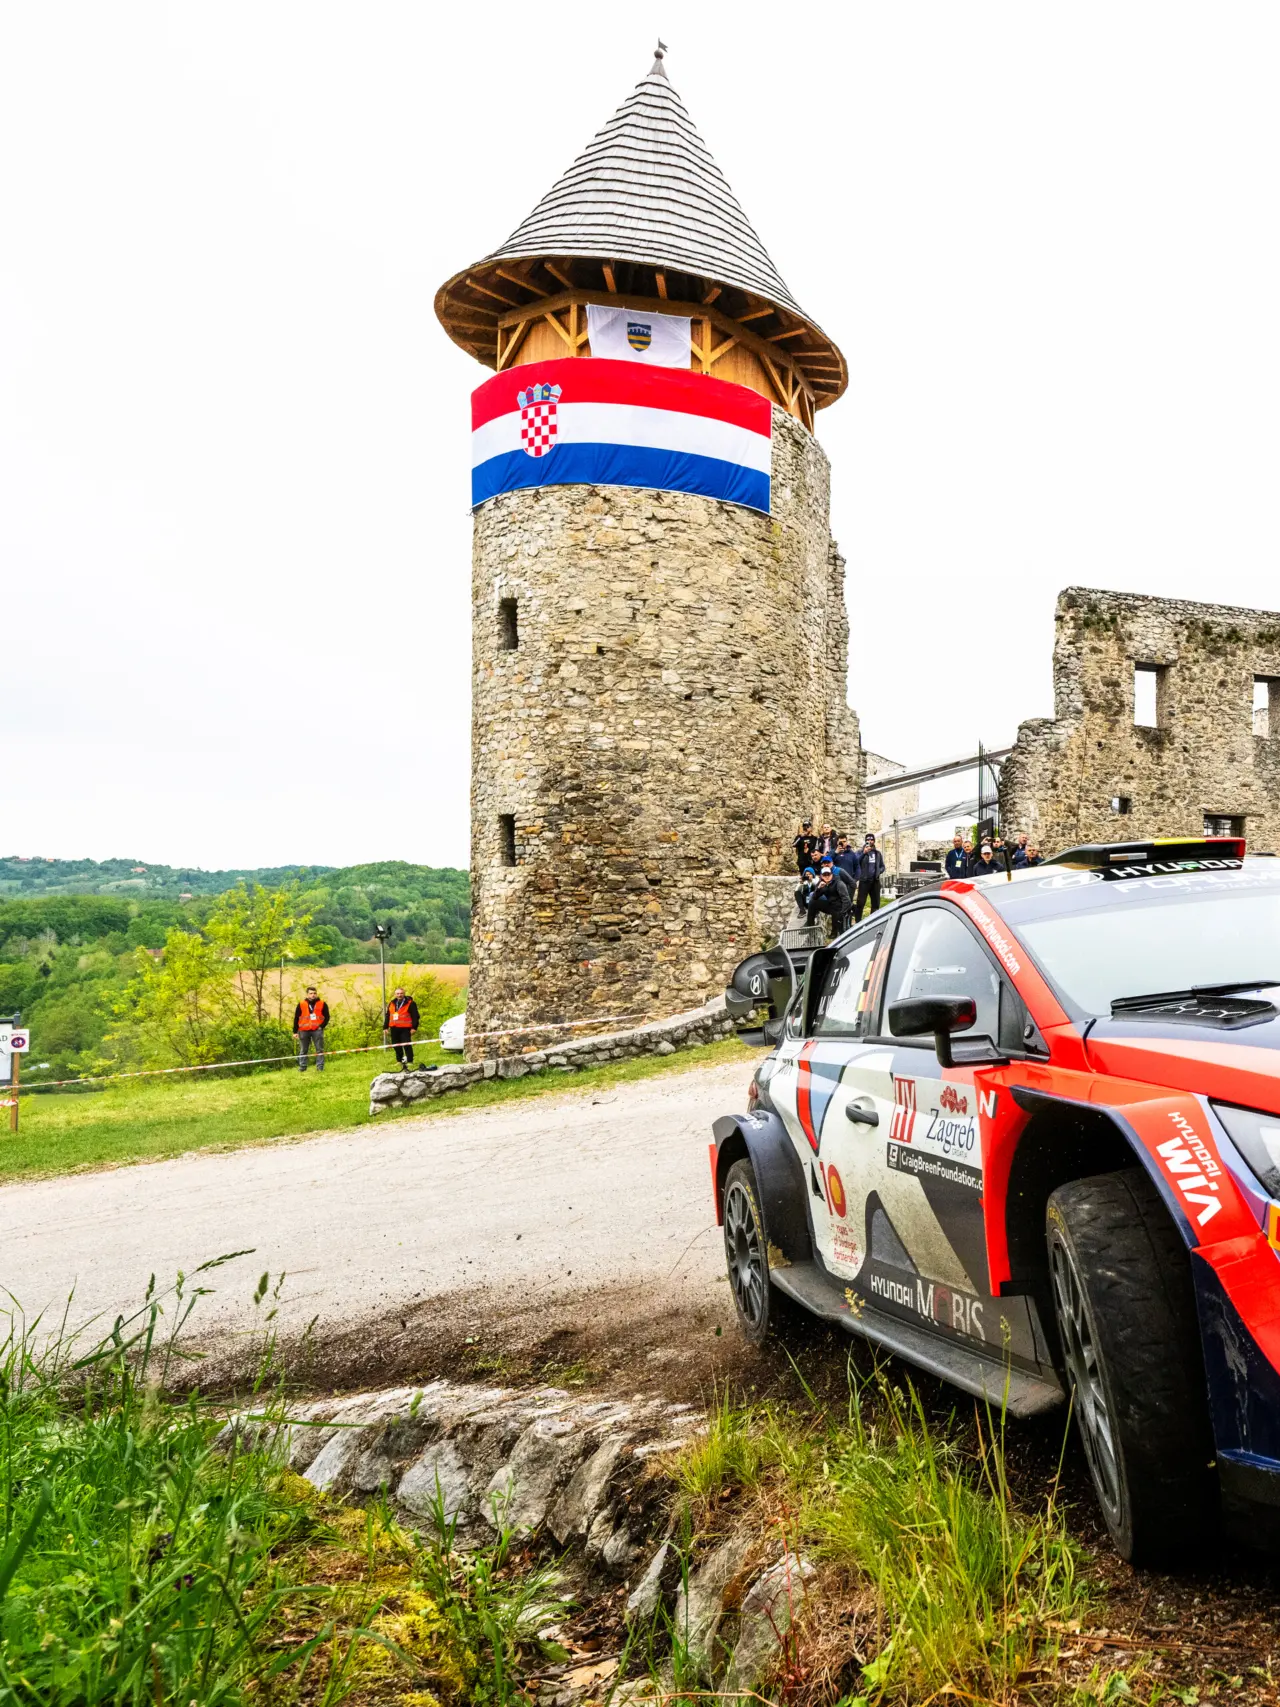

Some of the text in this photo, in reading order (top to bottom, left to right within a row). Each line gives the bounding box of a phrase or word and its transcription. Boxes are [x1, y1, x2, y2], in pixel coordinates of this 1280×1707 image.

[1111, 858, 1245, 878] HYUNDA
[926, 1107, 975, 1154] Zagreb
[1167, 1111, 1222, 1177] HYUNDAI
[901, 1150, 983, 1192] CraigBreenFoundation.c
[1156, 1136, 1222, 1227] WIA
[870, 1273, 914, 1309] HYUNDAI
